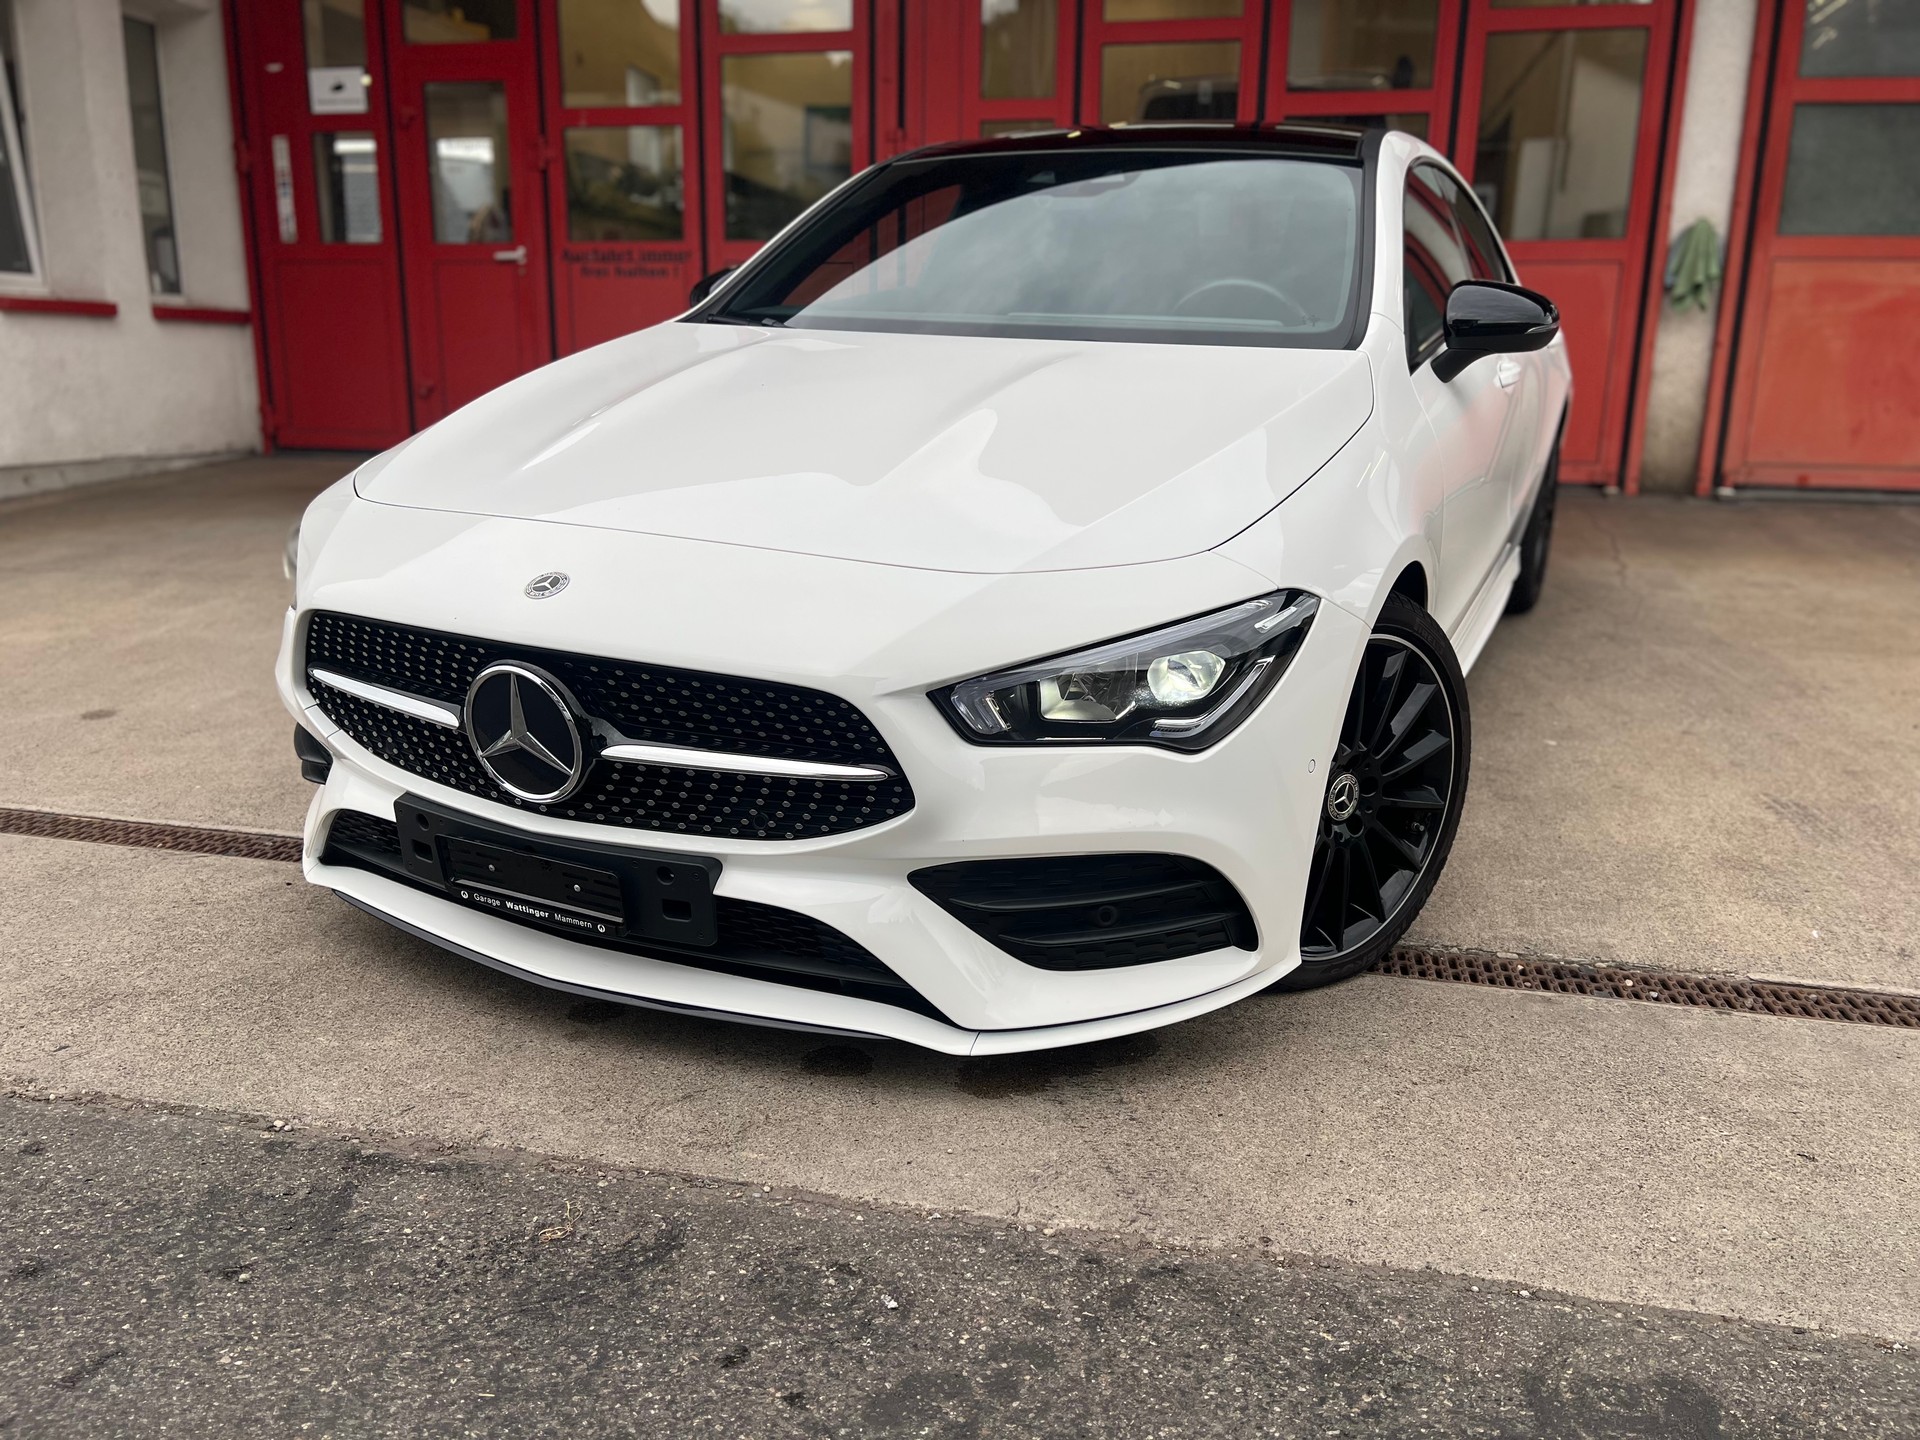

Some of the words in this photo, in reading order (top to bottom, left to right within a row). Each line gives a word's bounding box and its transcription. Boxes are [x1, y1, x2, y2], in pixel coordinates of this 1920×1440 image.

[473, 893, 501, 907] Garage
[505, 900, 550, 918] Wattinger
[554, 912, 593, 929] Mammern
